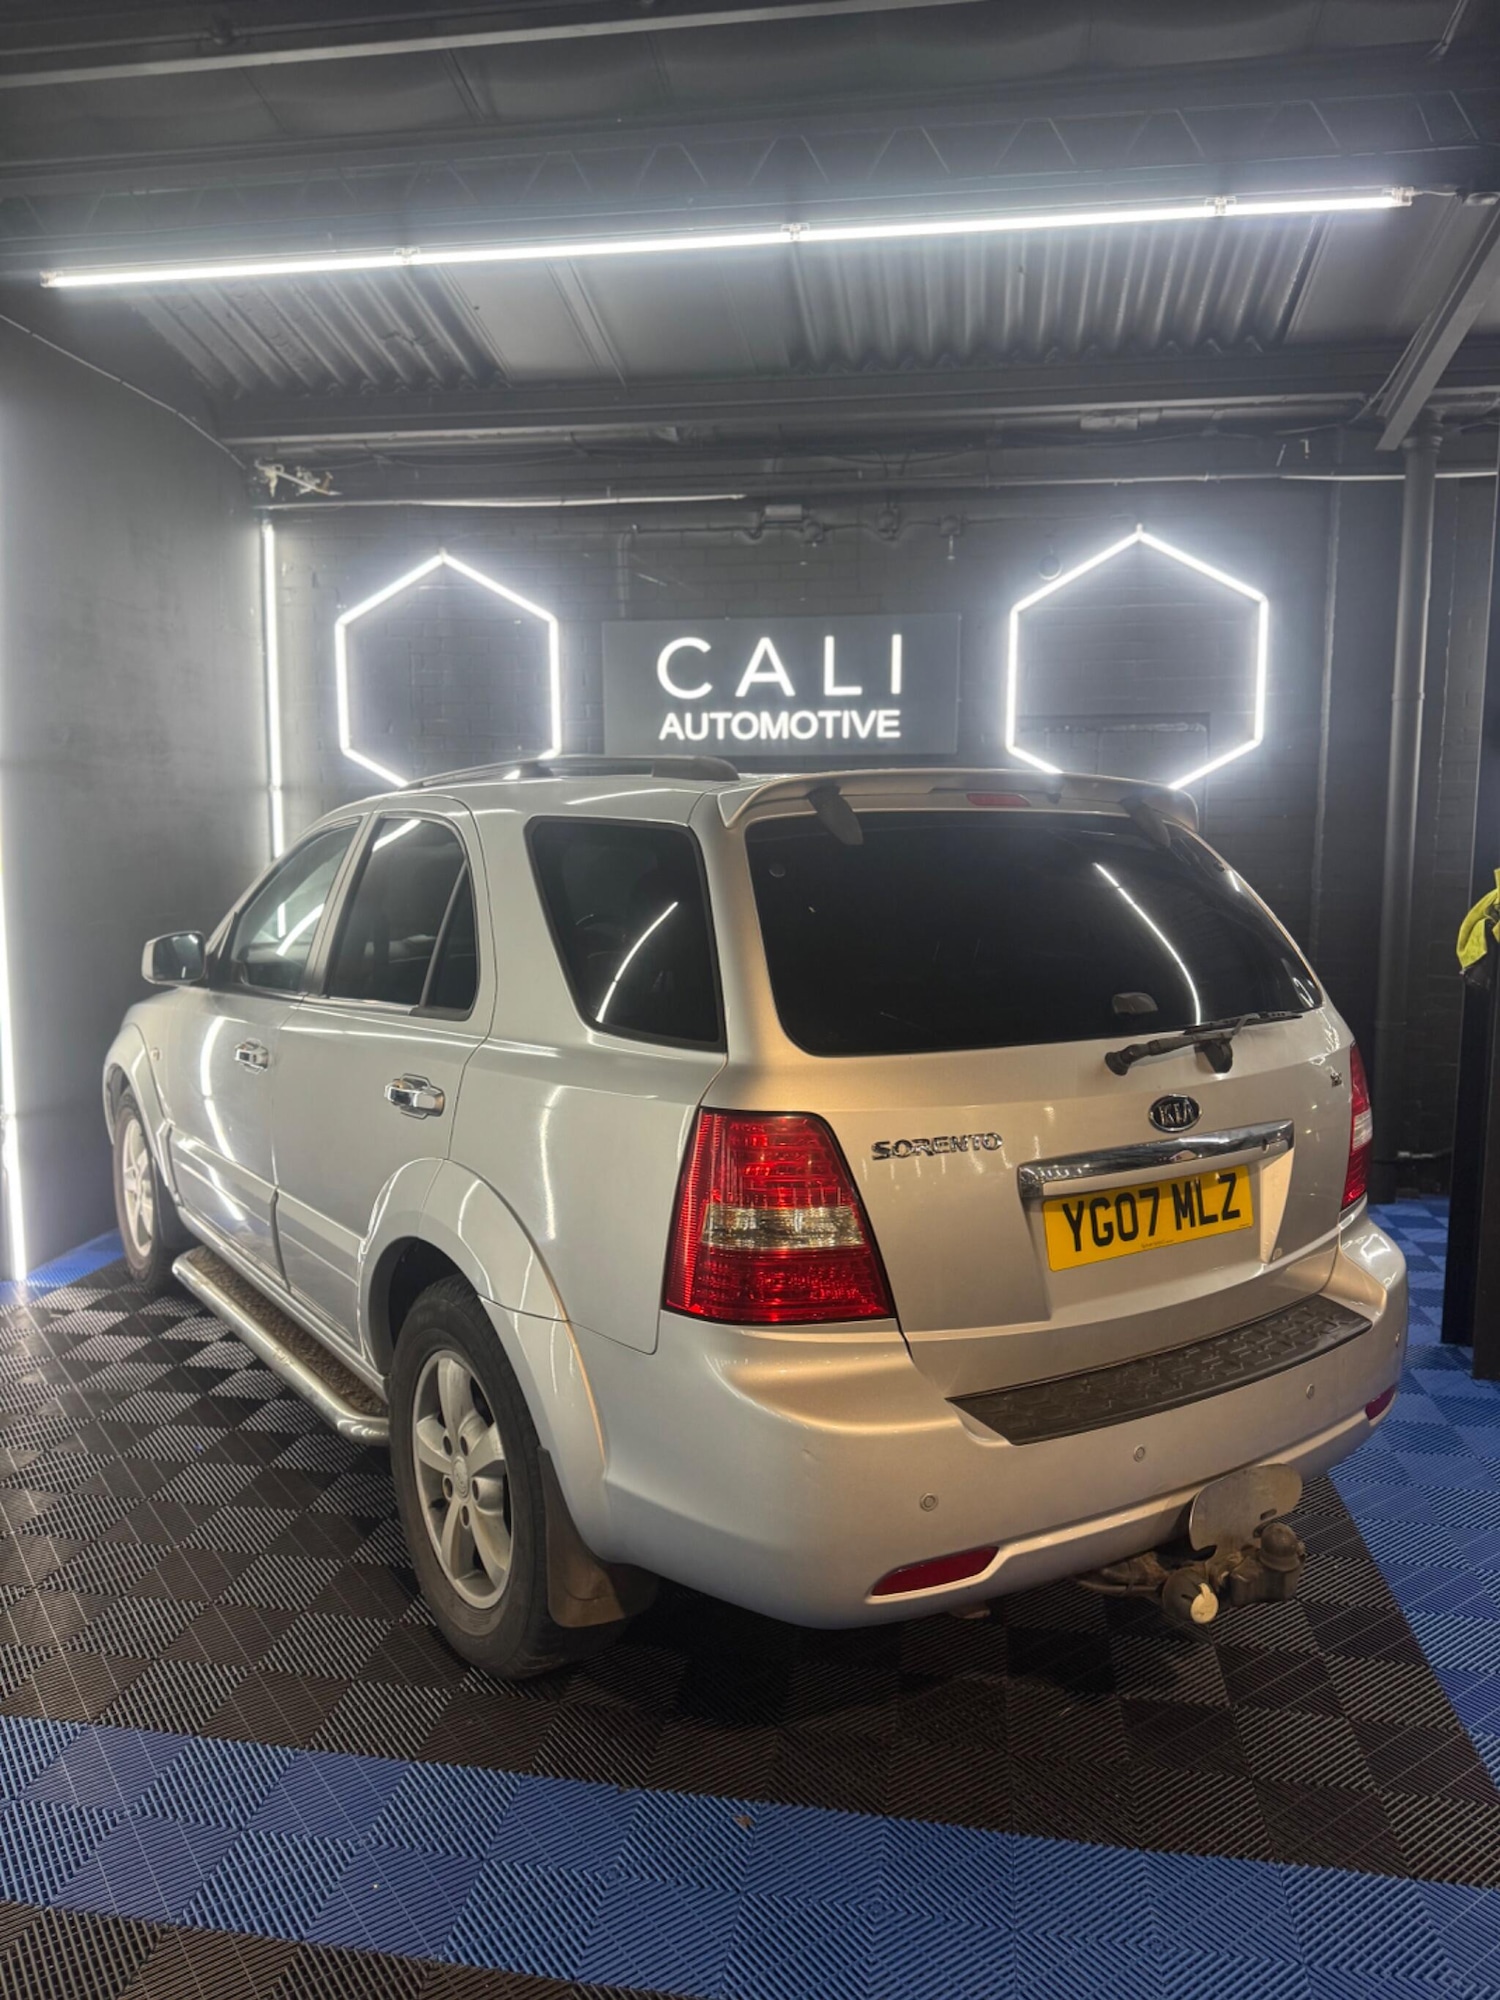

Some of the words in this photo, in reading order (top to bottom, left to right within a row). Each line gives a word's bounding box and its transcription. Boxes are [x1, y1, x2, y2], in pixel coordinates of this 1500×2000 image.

[656, 634, 902, 699] CALI
[658, 709, 902, 741] AUTOMOTIVE
[871, 1132, 1003, 1160] SORENTO
[1062, 1187, 1160, 1252] YG07
[1171, 1172, 1241, 1231] MLZ
